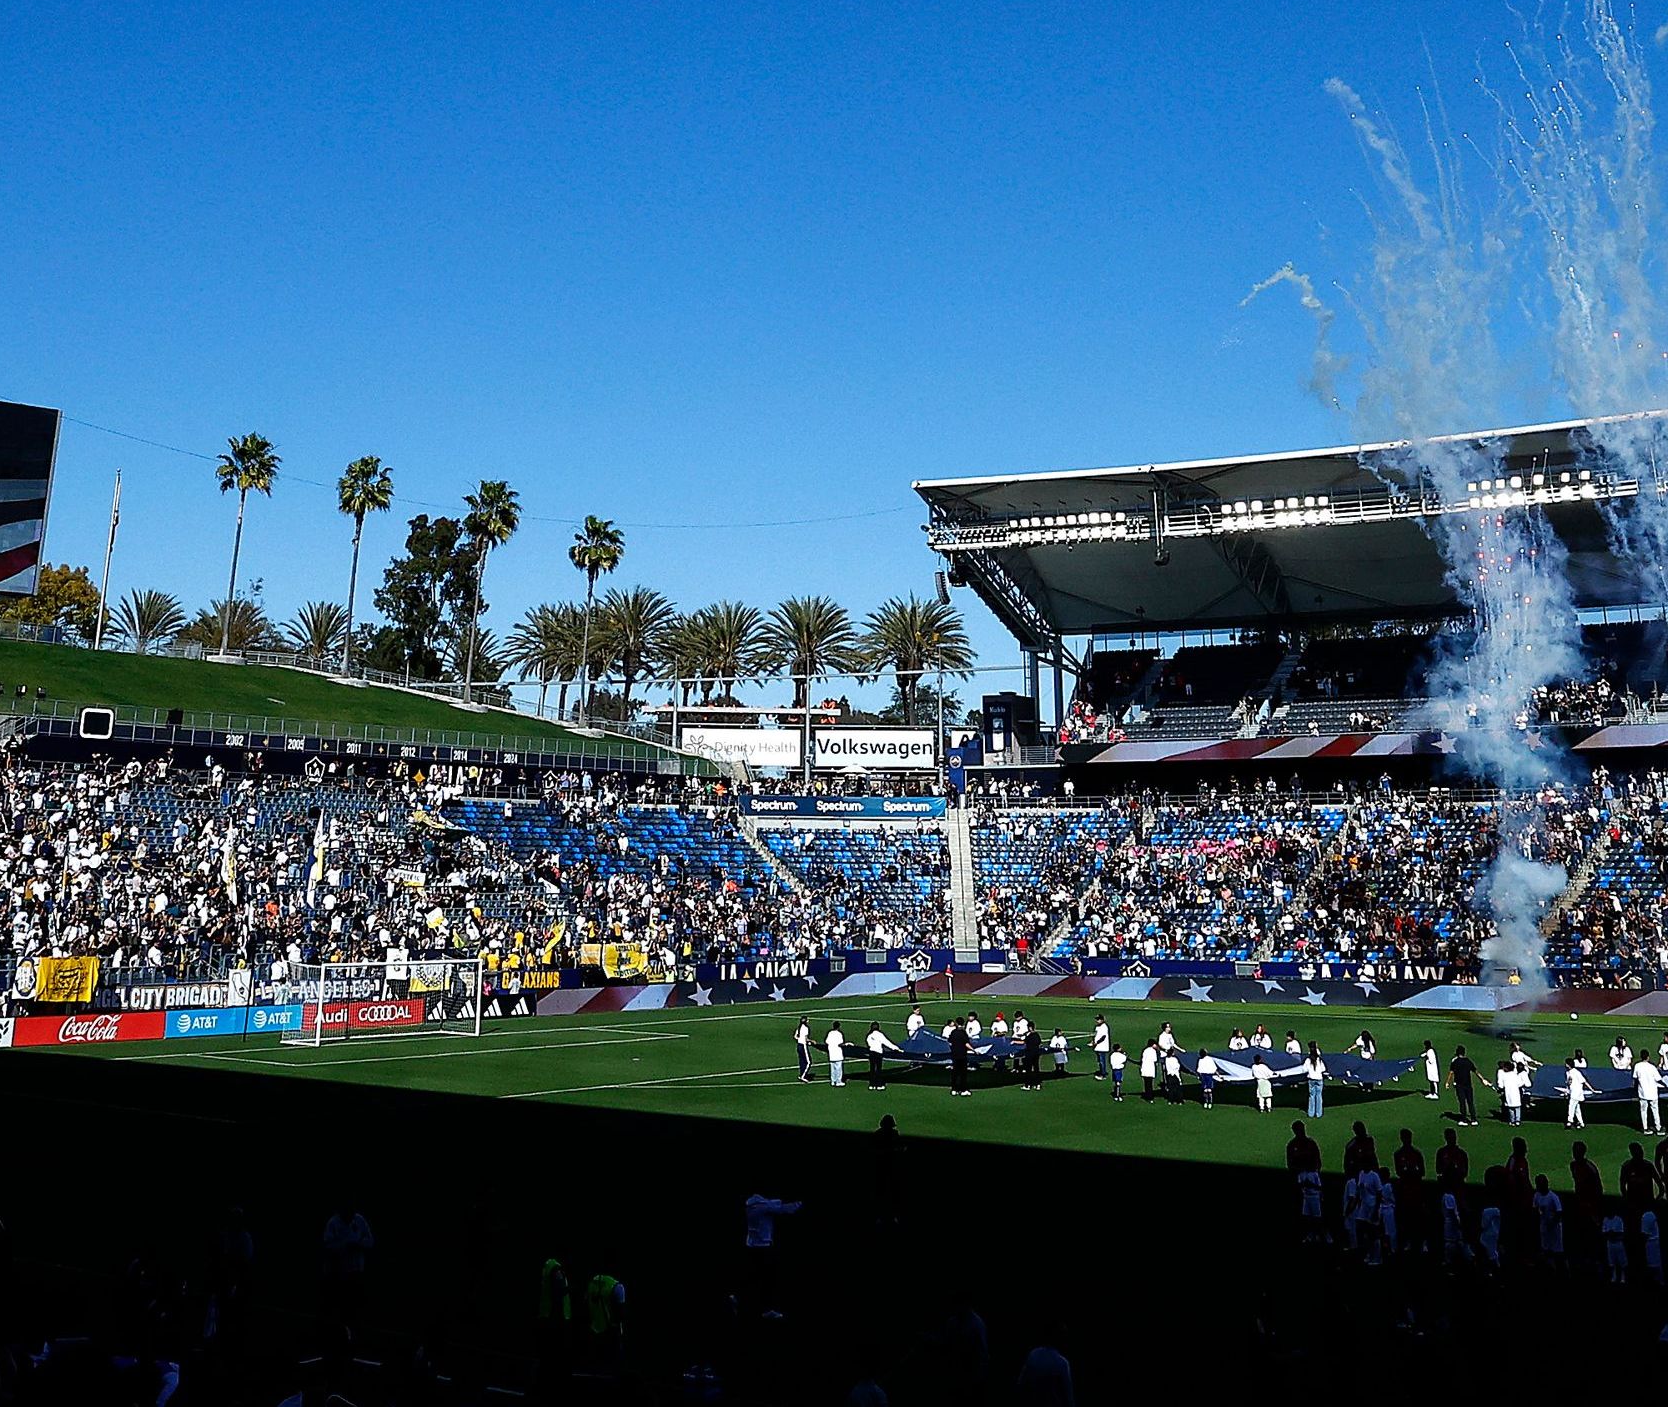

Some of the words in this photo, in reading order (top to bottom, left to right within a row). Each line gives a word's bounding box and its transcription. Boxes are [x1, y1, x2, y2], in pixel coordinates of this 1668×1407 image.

[225, 734, 244, 747] 2002
[346, 742, 362, 754] 2011
[400, 746, 416, 757] 2012
[714, 741, 755, 756] Dignity
[758, 742, 796, 753] Health
[817, 738, 933, 758] Volkswagen
[503, 753, 518, 764] 2024
[750, 799, 795, 812] Spectrum
[816, 799, 860, 812] Spectrum
[883, 799, 928, 812] Spectrum
[502, 971, 560, 989] GAXIANS
[131, 985, 164, 1009] CITY
[192, 1015, 218, 1030] AT&T
[267, 1011, 293, 1025] AT&T
[314, 1008, 348, 1024] Audi
[59, 1014, 122, 1042] Coca-Cola
